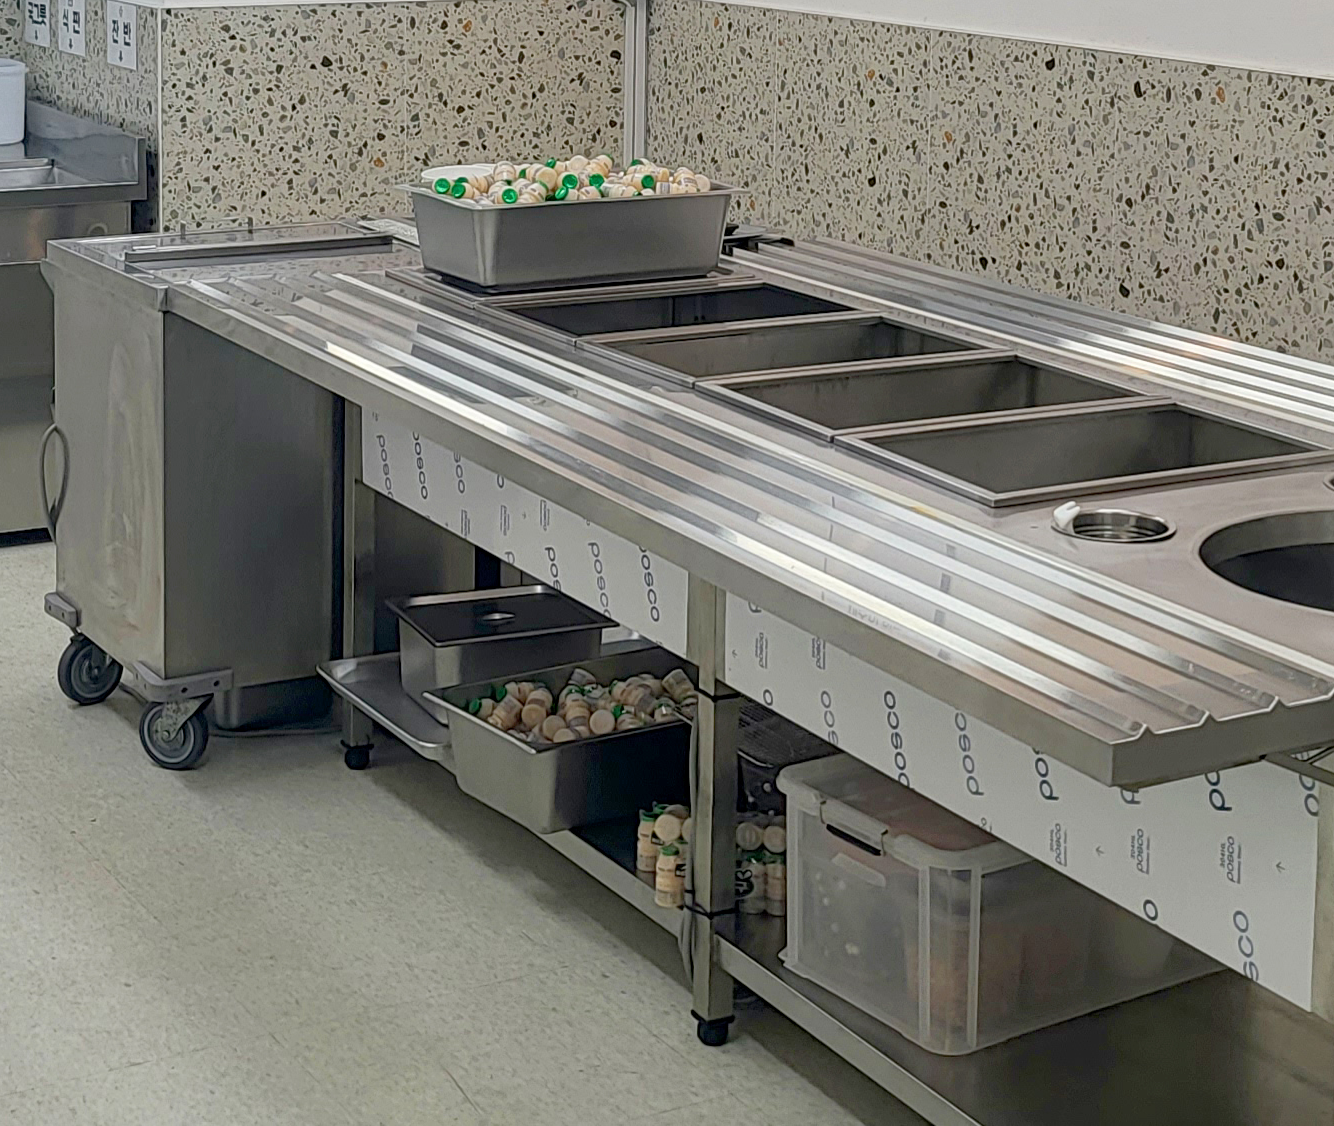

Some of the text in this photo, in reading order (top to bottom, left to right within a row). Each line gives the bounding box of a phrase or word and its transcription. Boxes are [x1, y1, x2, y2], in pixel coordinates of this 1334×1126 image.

[545, 546, 562, 592] pos
[954, 712, 984, 796] posc
[1226, 836, 1235, 883] posco
